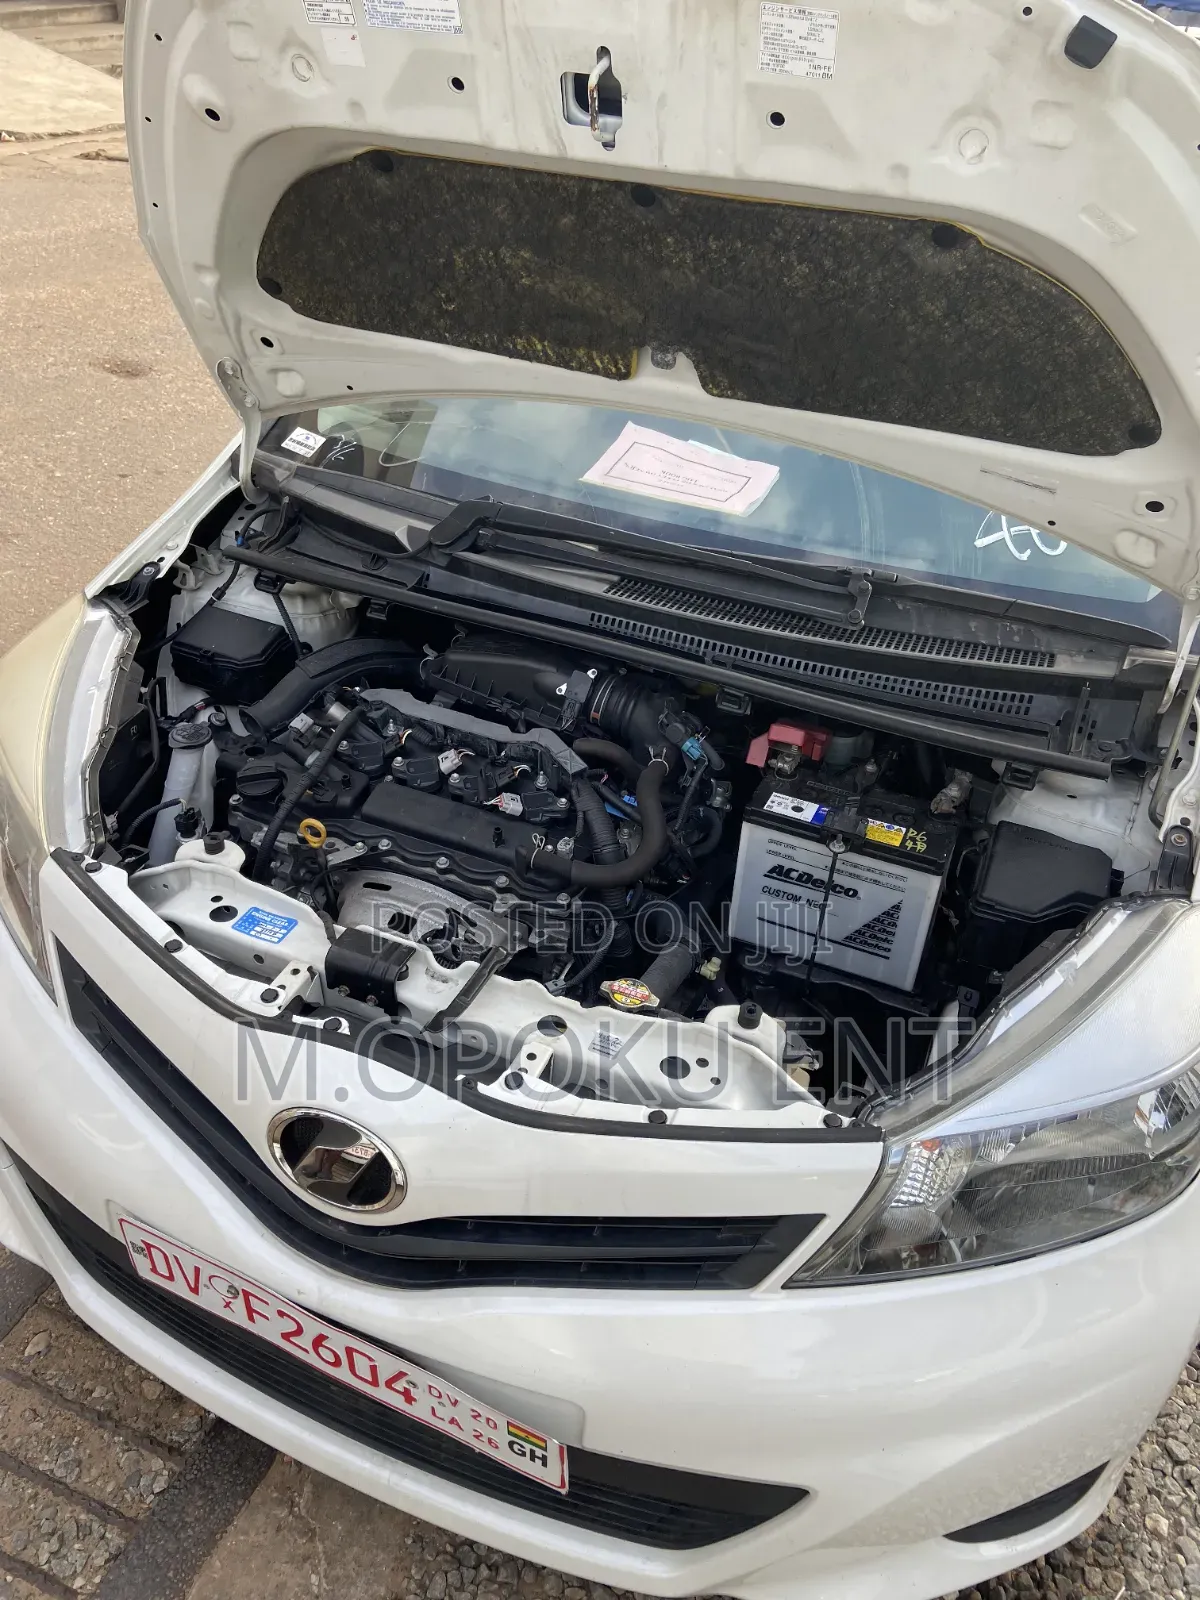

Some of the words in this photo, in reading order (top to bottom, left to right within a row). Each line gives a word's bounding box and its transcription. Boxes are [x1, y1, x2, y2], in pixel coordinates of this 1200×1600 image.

[761, 885, 802, 904] CUSTOM
[766, 863, 859, 899] ACDeco
[843, 936, 891, 953] ACDelco
[140, 1239, 201, 1296] DV
[241, 1288, 418, 1406] F2604
[428, 1384, 459, 1407] DV
[470, 1408, 498, 1431] 20
[431, 1406, 464, 1432] LA
[472, 1428, 500, 1450] 26
[508, 1440, 548, 1468] GH
